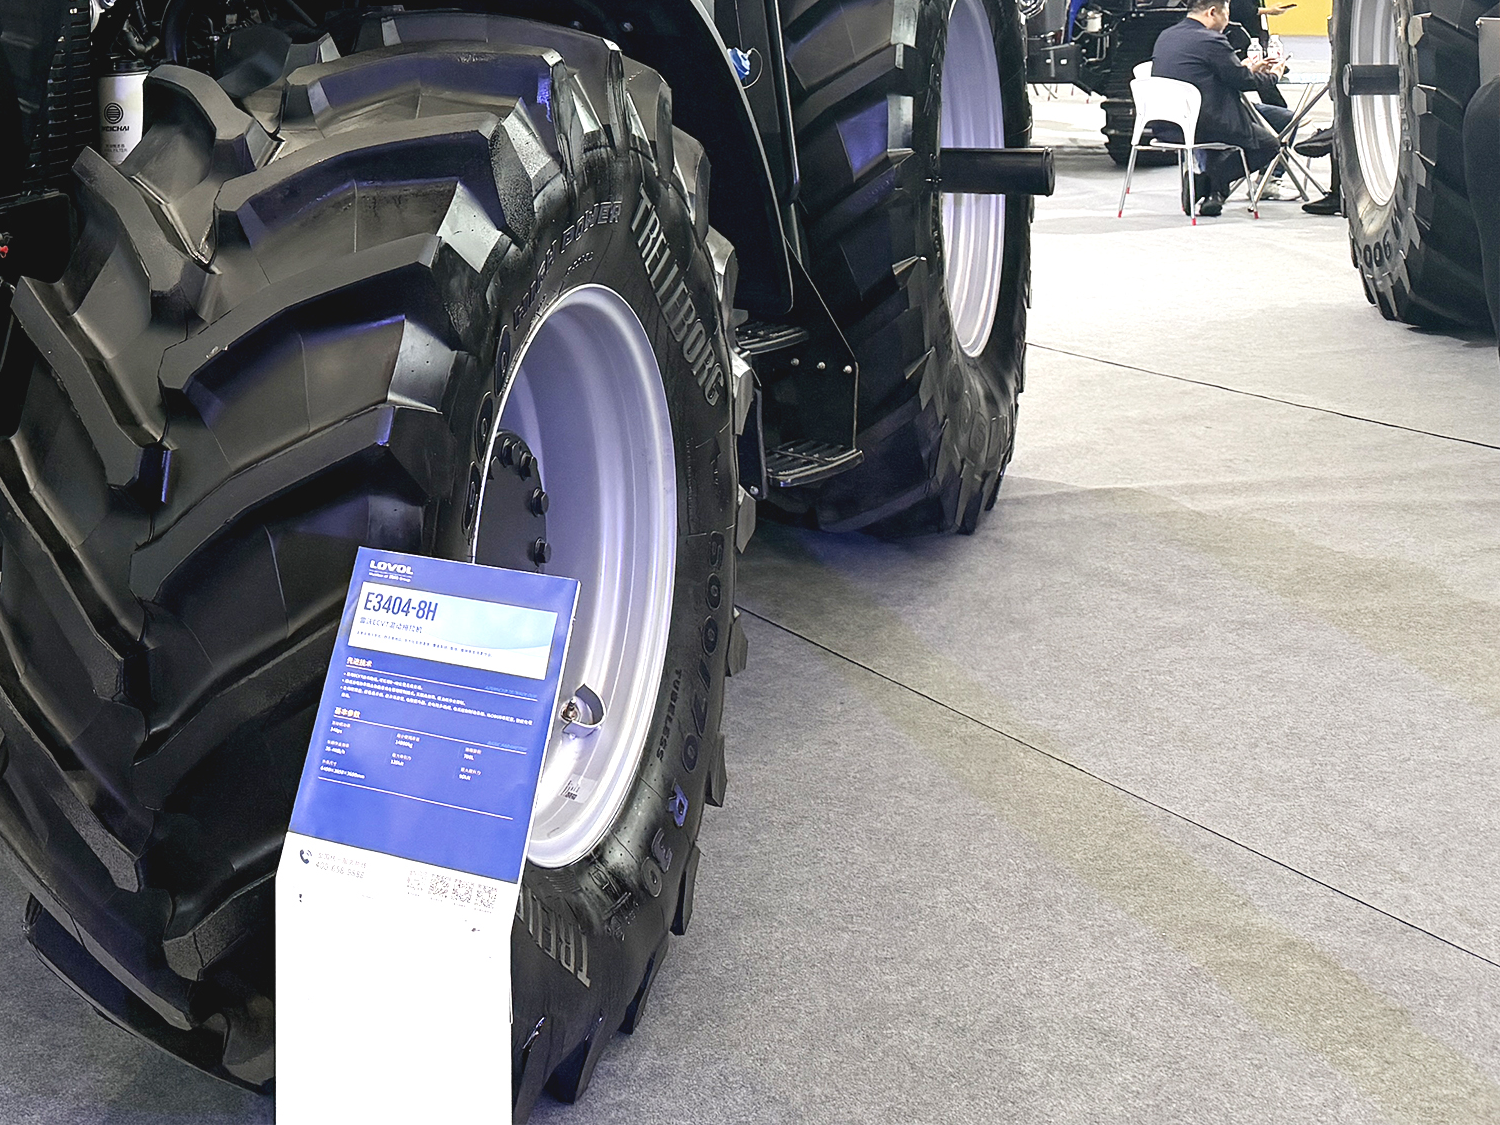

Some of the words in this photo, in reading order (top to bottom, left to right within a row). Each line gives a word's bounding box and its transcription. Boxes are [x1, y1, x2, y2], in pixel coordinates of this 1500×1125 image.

[560, 200, 623, 255] POWER
[630, 183, 727, 407] TRELLEBORG
[369, 559, 414, 576] LOVOL
[363, 591, 439, 622] E3404-8H
[655, 669, 683, 763] TUBELESS
